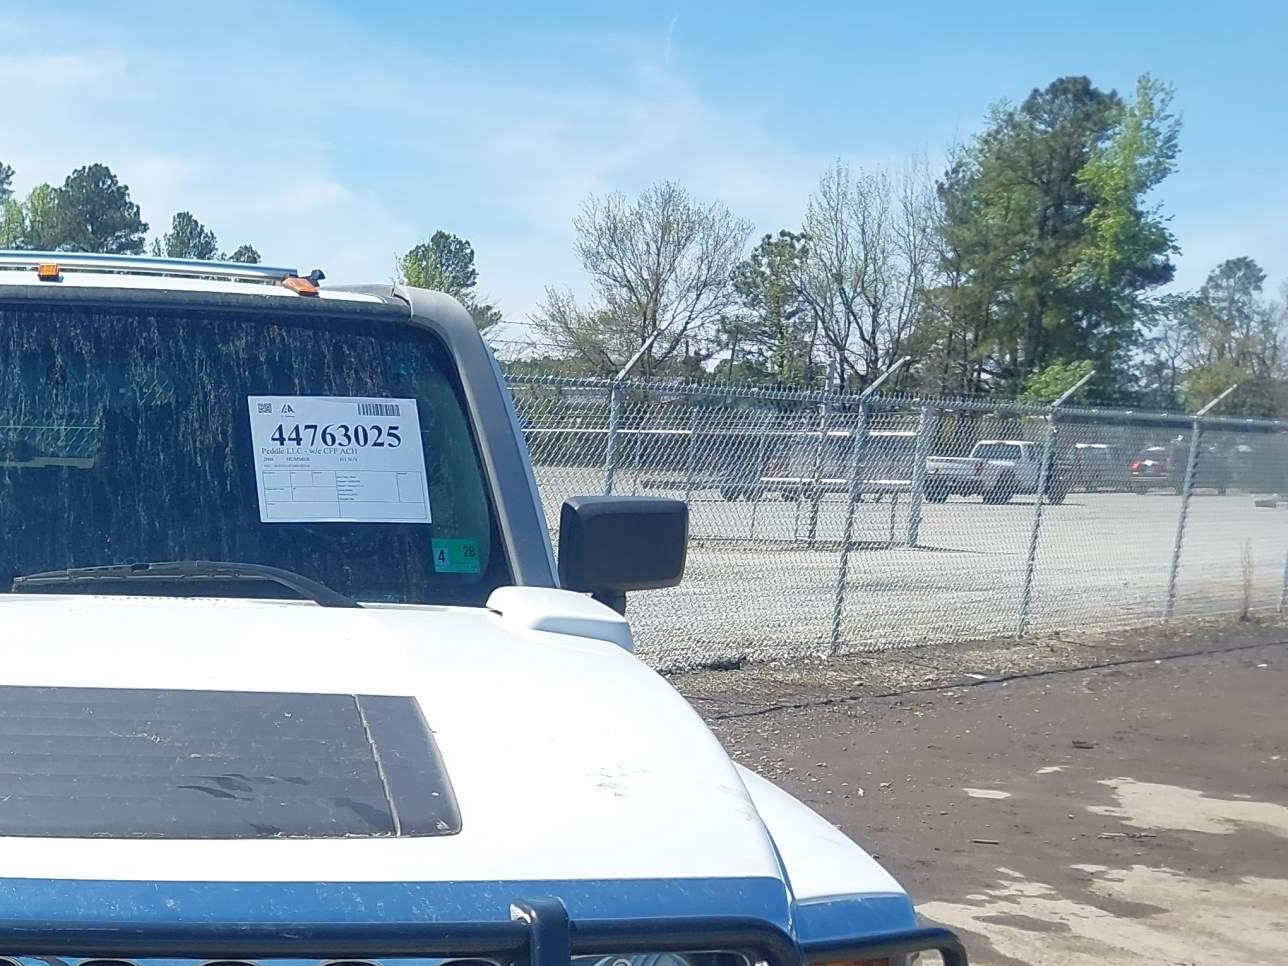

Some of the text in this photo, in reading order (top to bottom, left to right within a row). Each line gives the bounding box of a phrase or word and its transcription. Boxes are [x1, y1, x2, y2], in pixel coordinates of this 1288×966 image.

[270, 423, 402, 448] 44763025
[261, 447, 285, 455] Peddle
[286, 447, 303, 455] LLC
[438, 549, 446, 563] 4
